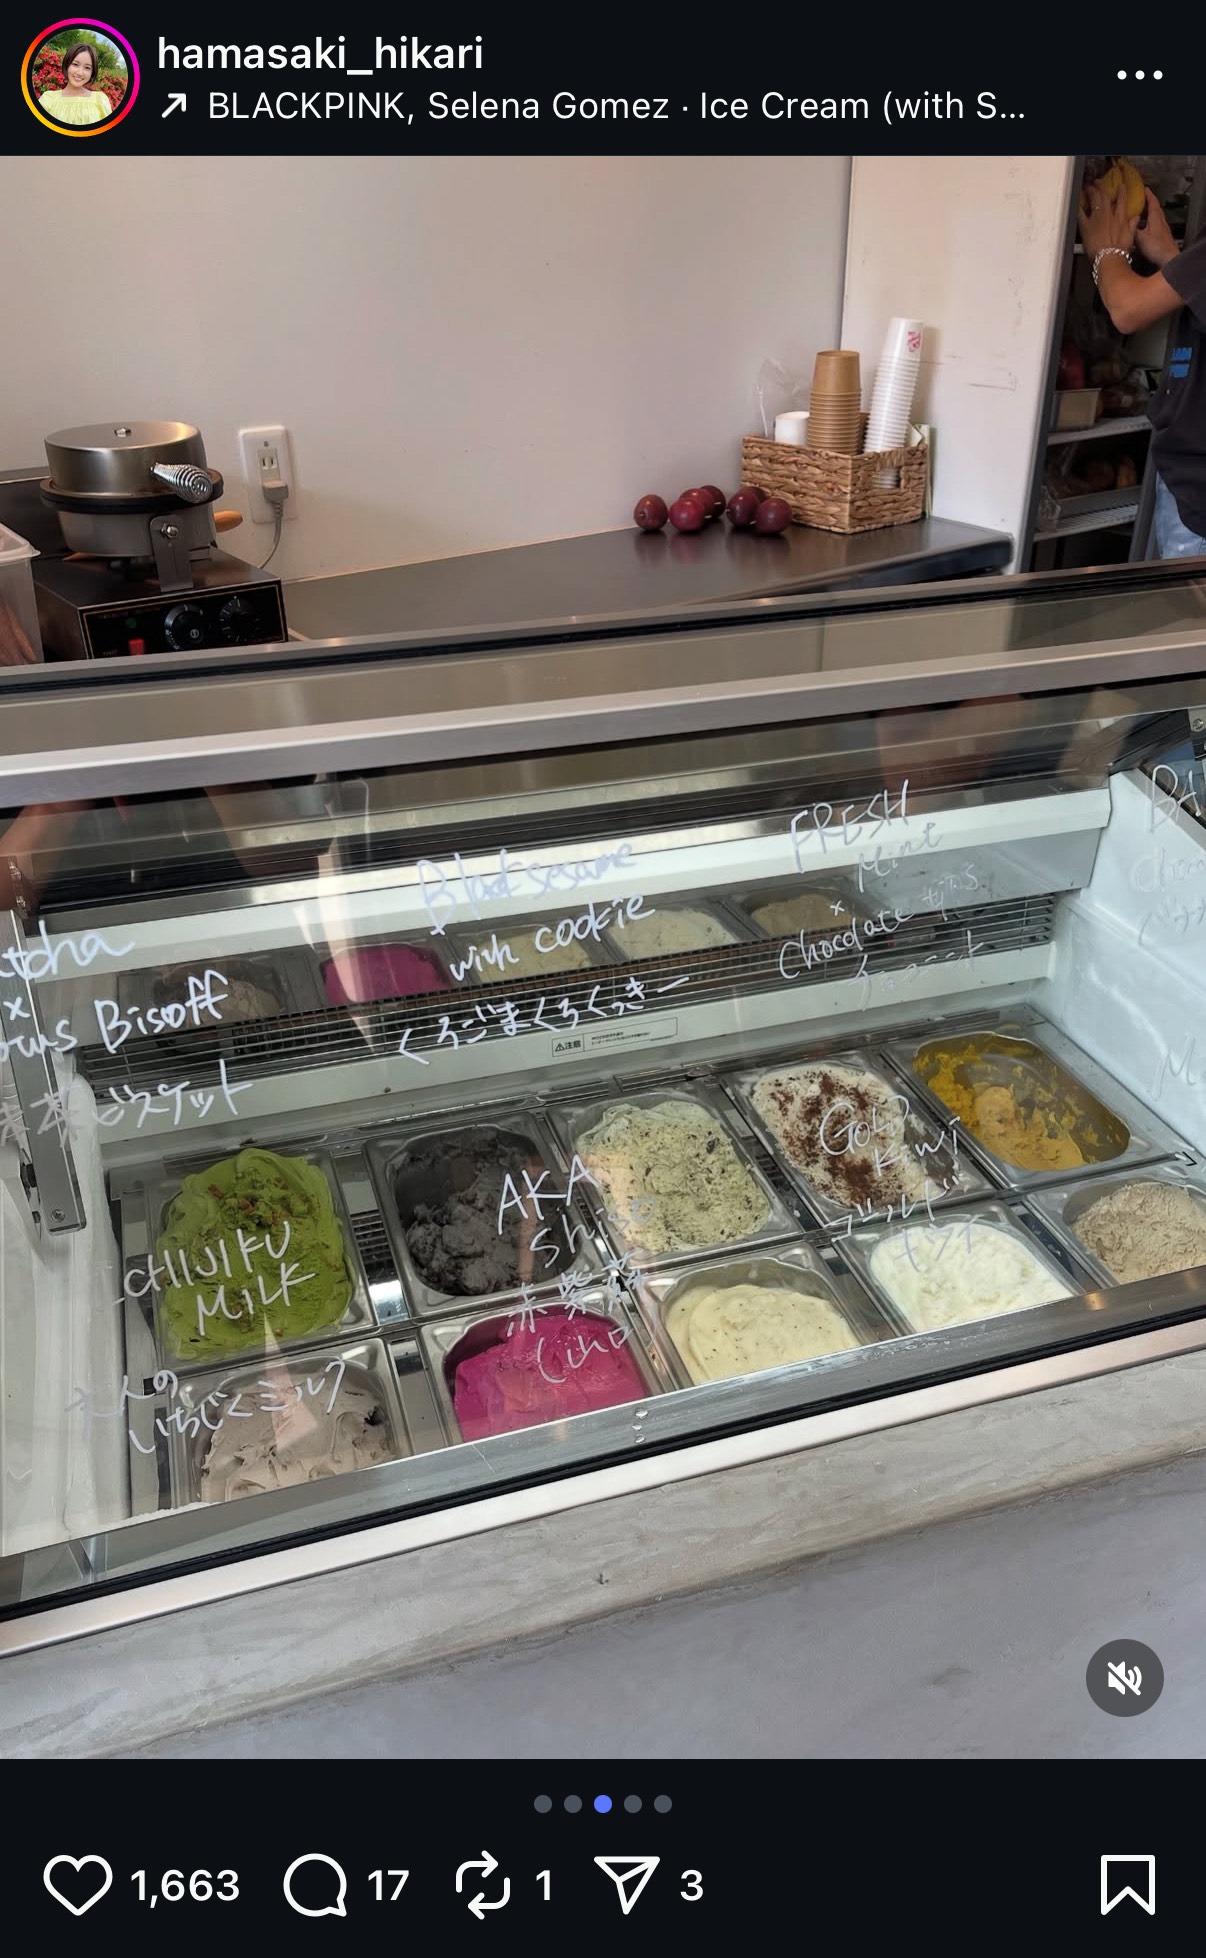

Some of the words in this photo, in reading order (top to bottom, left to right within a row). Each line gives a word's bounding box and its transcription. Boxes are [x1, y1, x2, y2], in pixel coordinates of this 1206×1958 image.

[791, 779, 909, 873] FRESH
[535, 895, 656, 953] cookie
[779, 908, 915, 980] Chocolate
[498, 1154, 600, 1236] AKA
